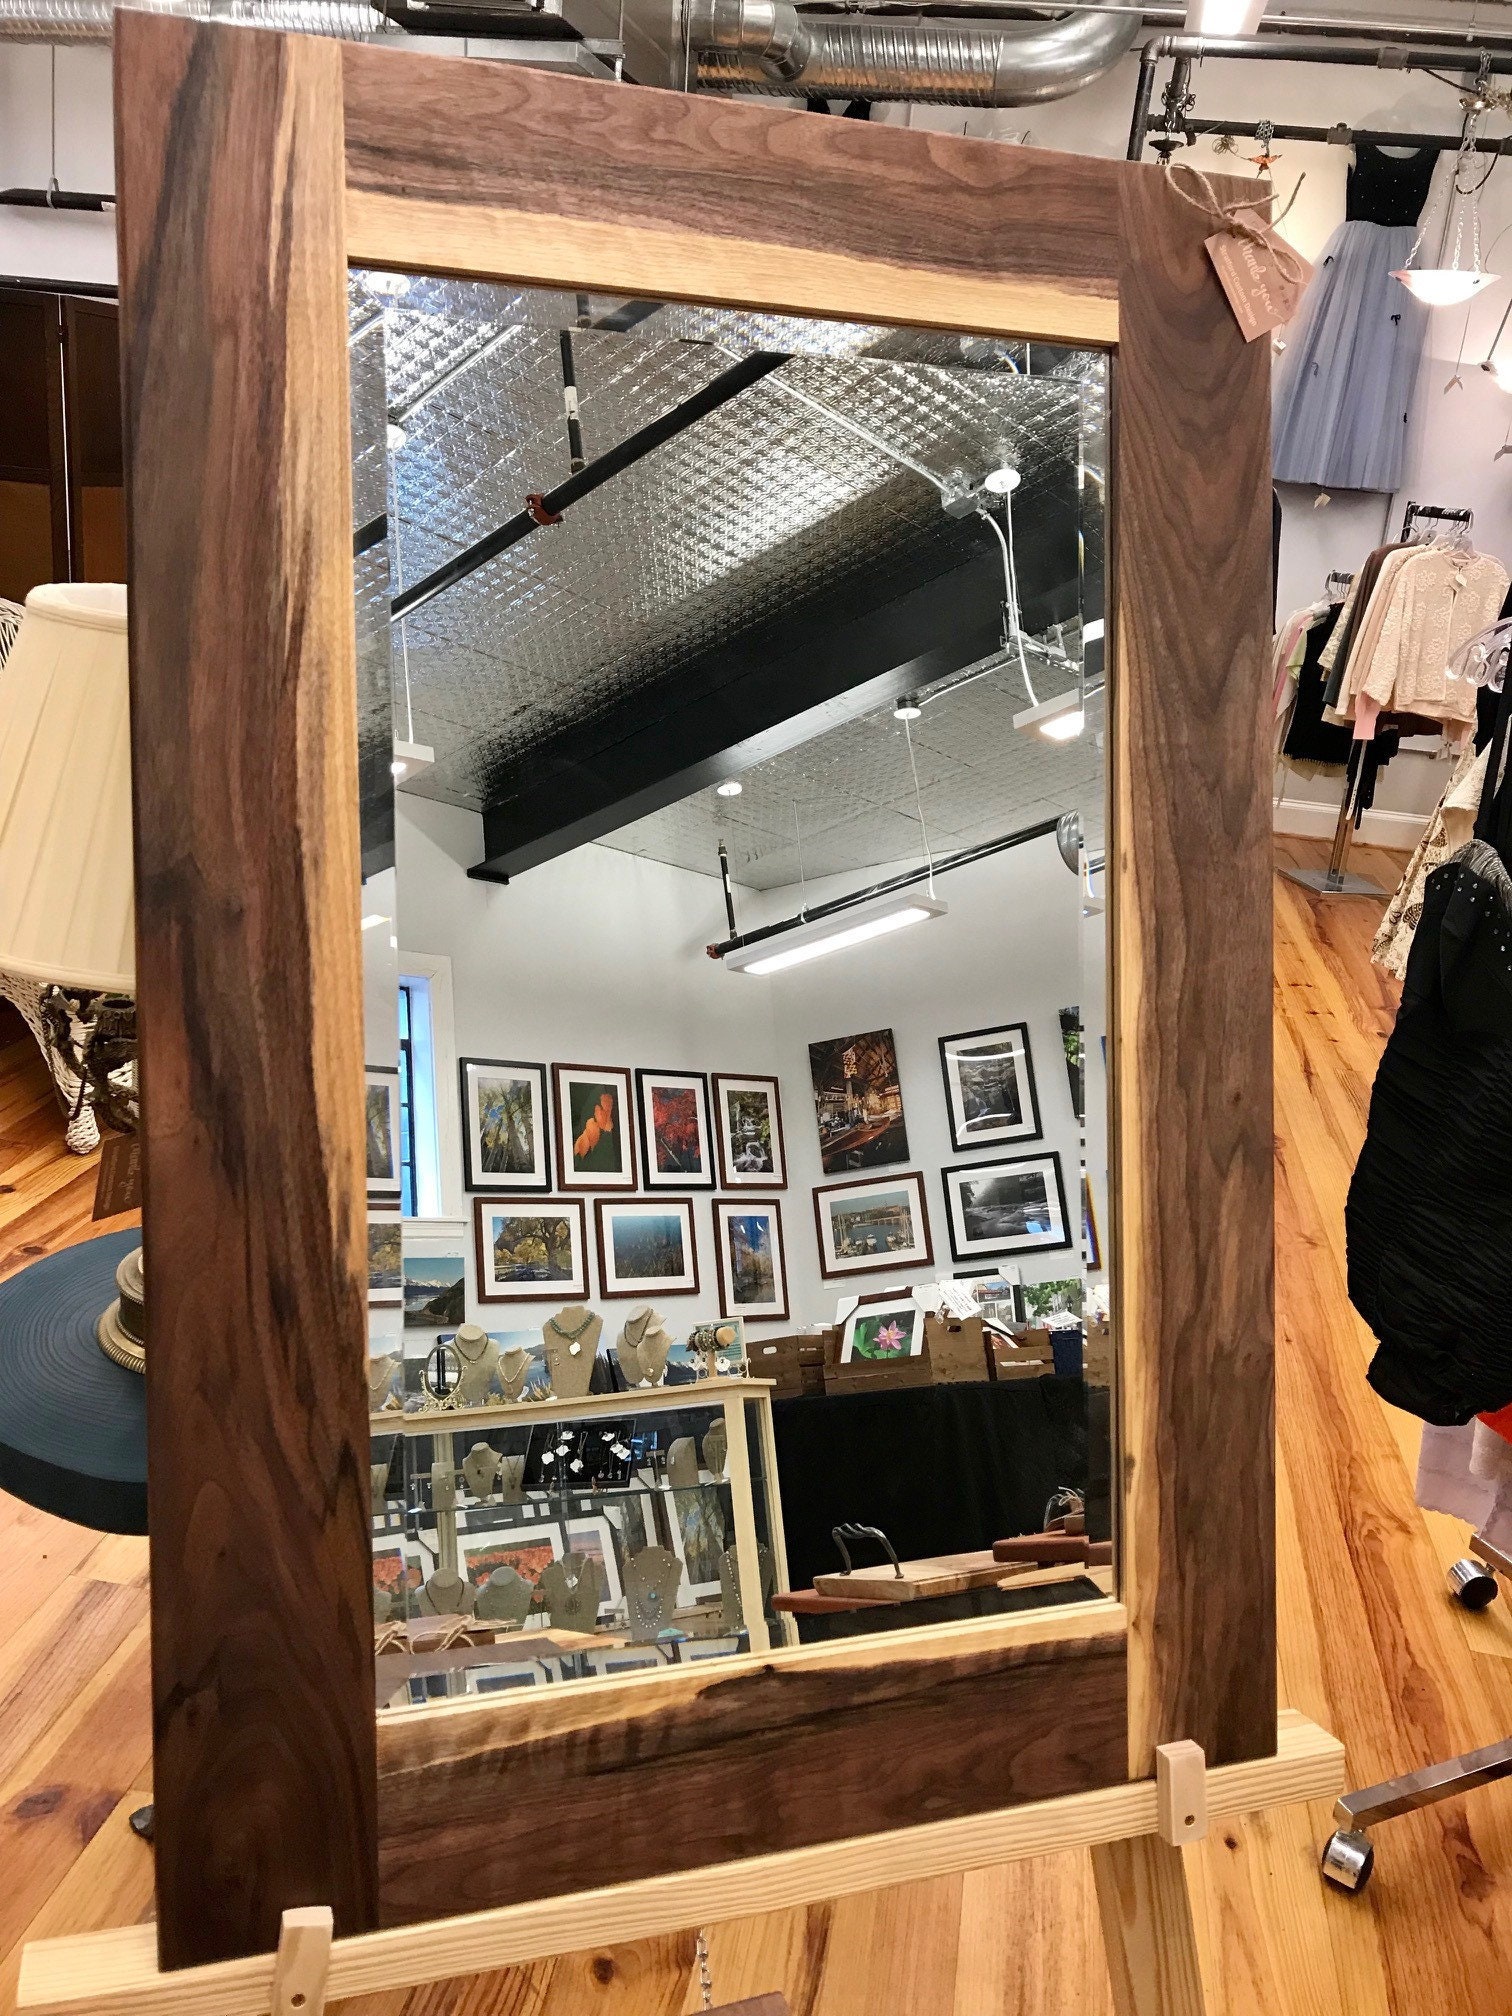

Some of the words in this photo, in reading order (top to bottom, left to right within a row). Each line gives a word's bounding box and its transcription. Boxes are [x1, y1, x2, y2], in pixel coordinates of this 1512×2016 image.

[1234, 276, 1247, 303] Custom
[1244, 302, 1257, 327] Design
[1251, 283, 1277, 315] you
